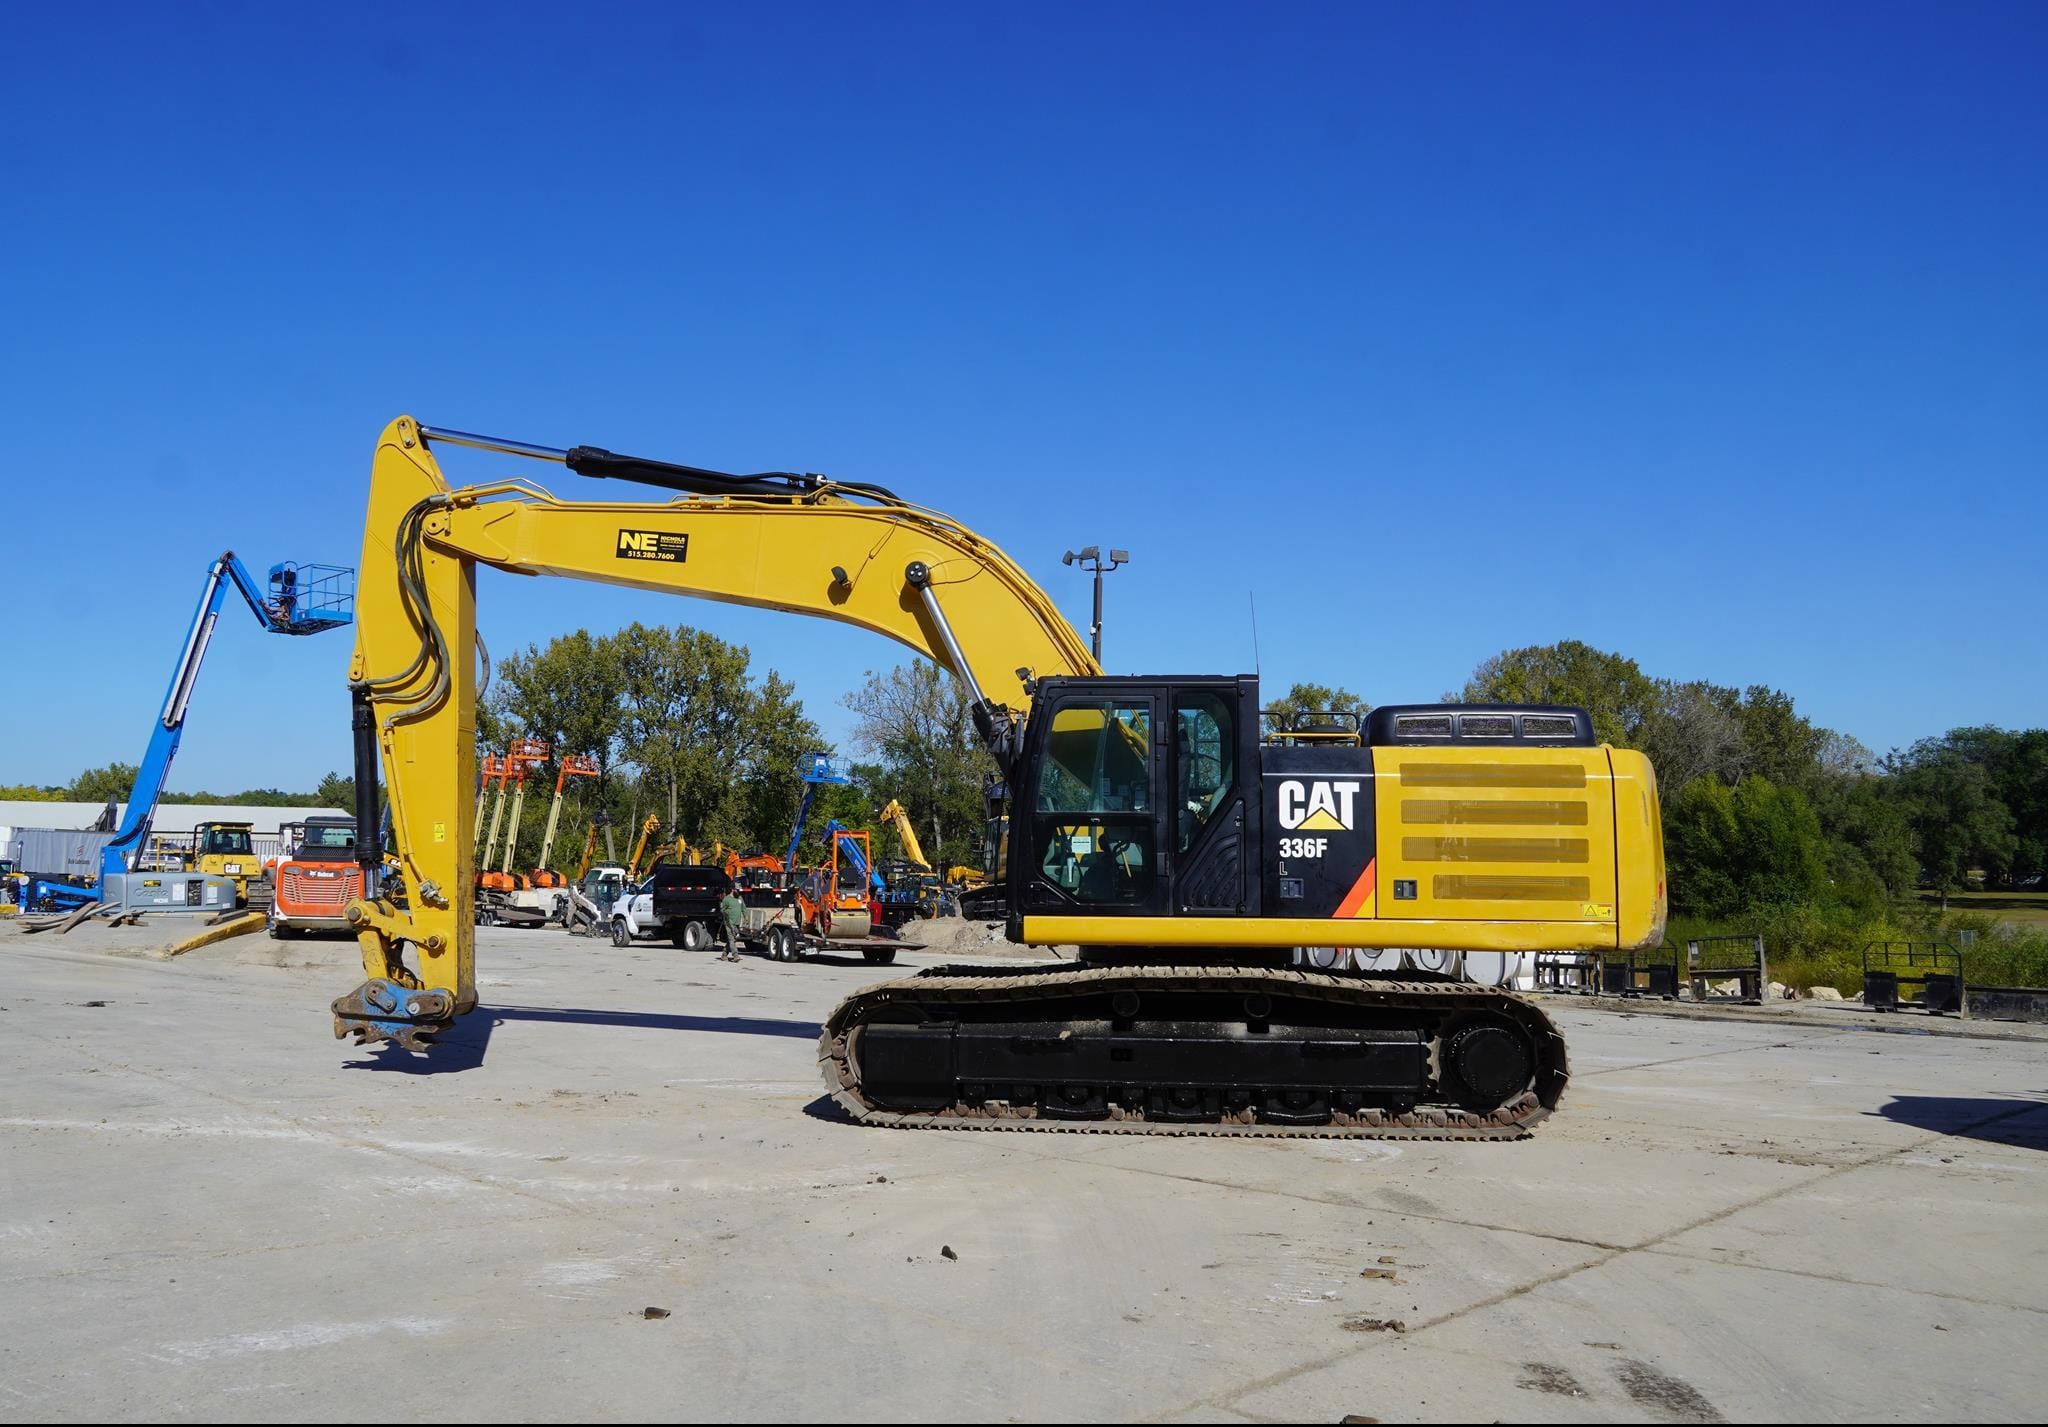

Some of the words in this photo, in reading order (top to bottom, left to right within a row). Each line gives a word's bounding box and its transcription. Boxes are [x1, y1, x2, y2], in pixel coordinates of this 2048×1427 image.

[620, 532, 659, 551] NE
[627, 551, 675, 560] 515.280.7600
[1278, 780, 1360, 831] CAT
[1279, 838, 1328, 858] 336F
[225, 864, 240, 873] CAT
[317, 870, 334, 878] Bobcat
[1279, 861, 1288, 876] L
